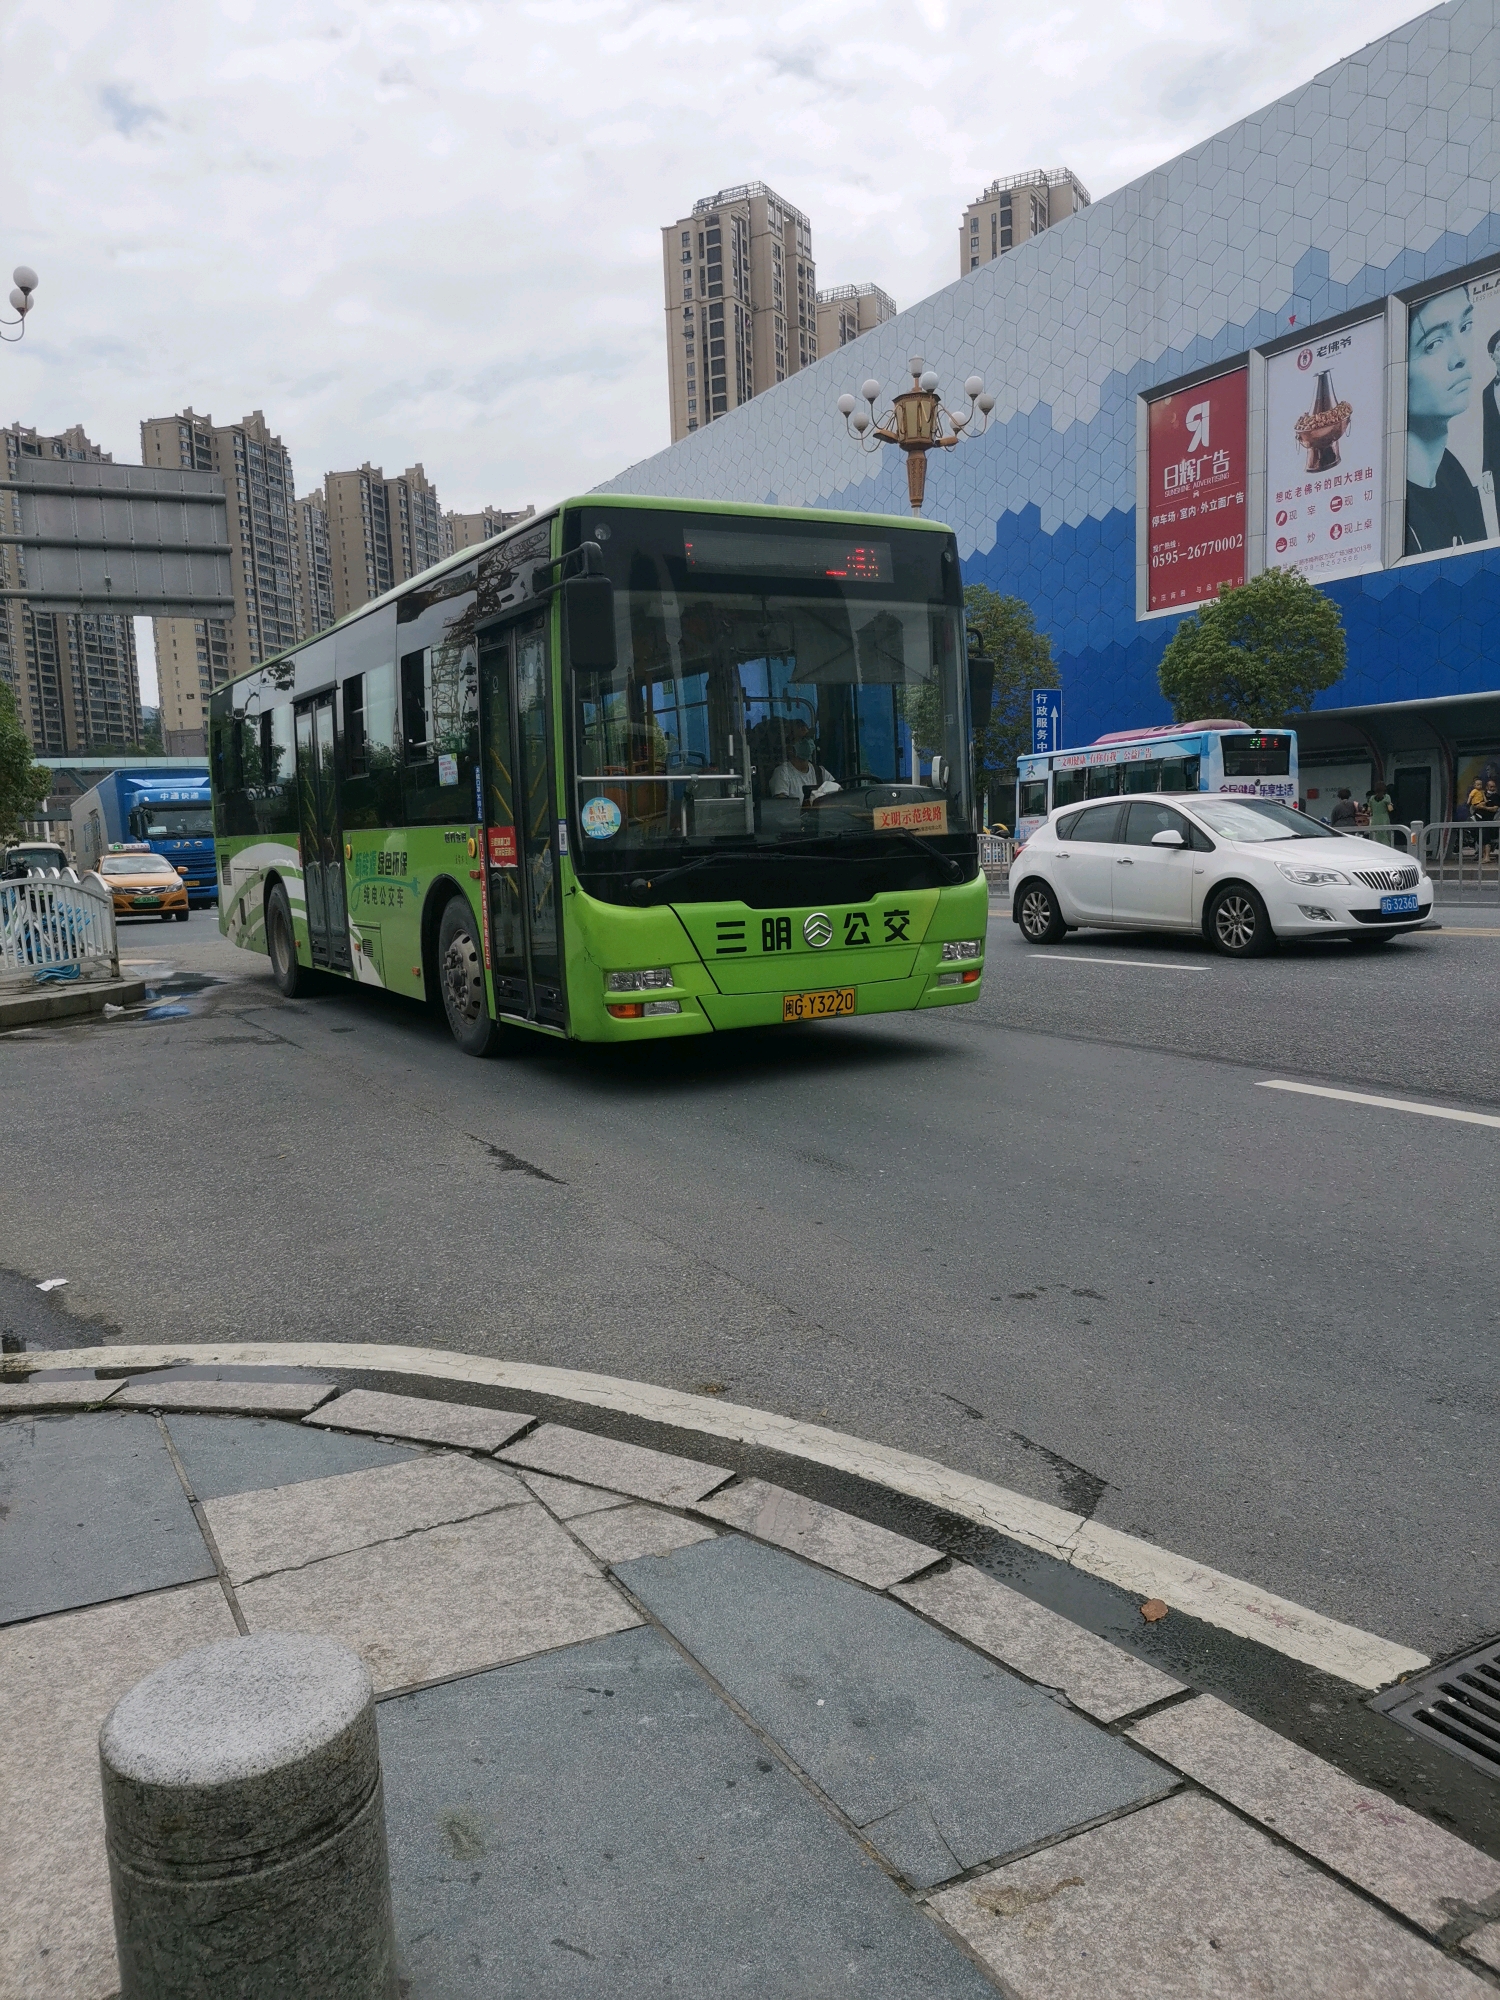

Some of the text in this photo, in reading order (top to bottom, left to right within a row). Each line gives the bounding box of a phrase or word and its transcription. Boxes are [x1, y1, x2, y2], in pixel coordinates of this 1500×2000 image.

[1317, 336, 1352, 357] 老佛爷
[1164, 449, 1230, 490] 日辉广告
[1193, 472, 1230, 488] ADVERTISING
[1276, 467, 1373, 503] 想吃老佛爷的四大理由
[1344, 519, 1372, 534] 现上桌
[1152, 533, 1243, 568] 0595-26770002
[1036, 693, 1048, 752] 行政服务中
[160, 792, 199, 800] 中通快递
[881, 806, 942, 828] 文明示范线路
[173, 841, 203, 849] JAC
[363, 885, 404, 908] 纯电公交车
